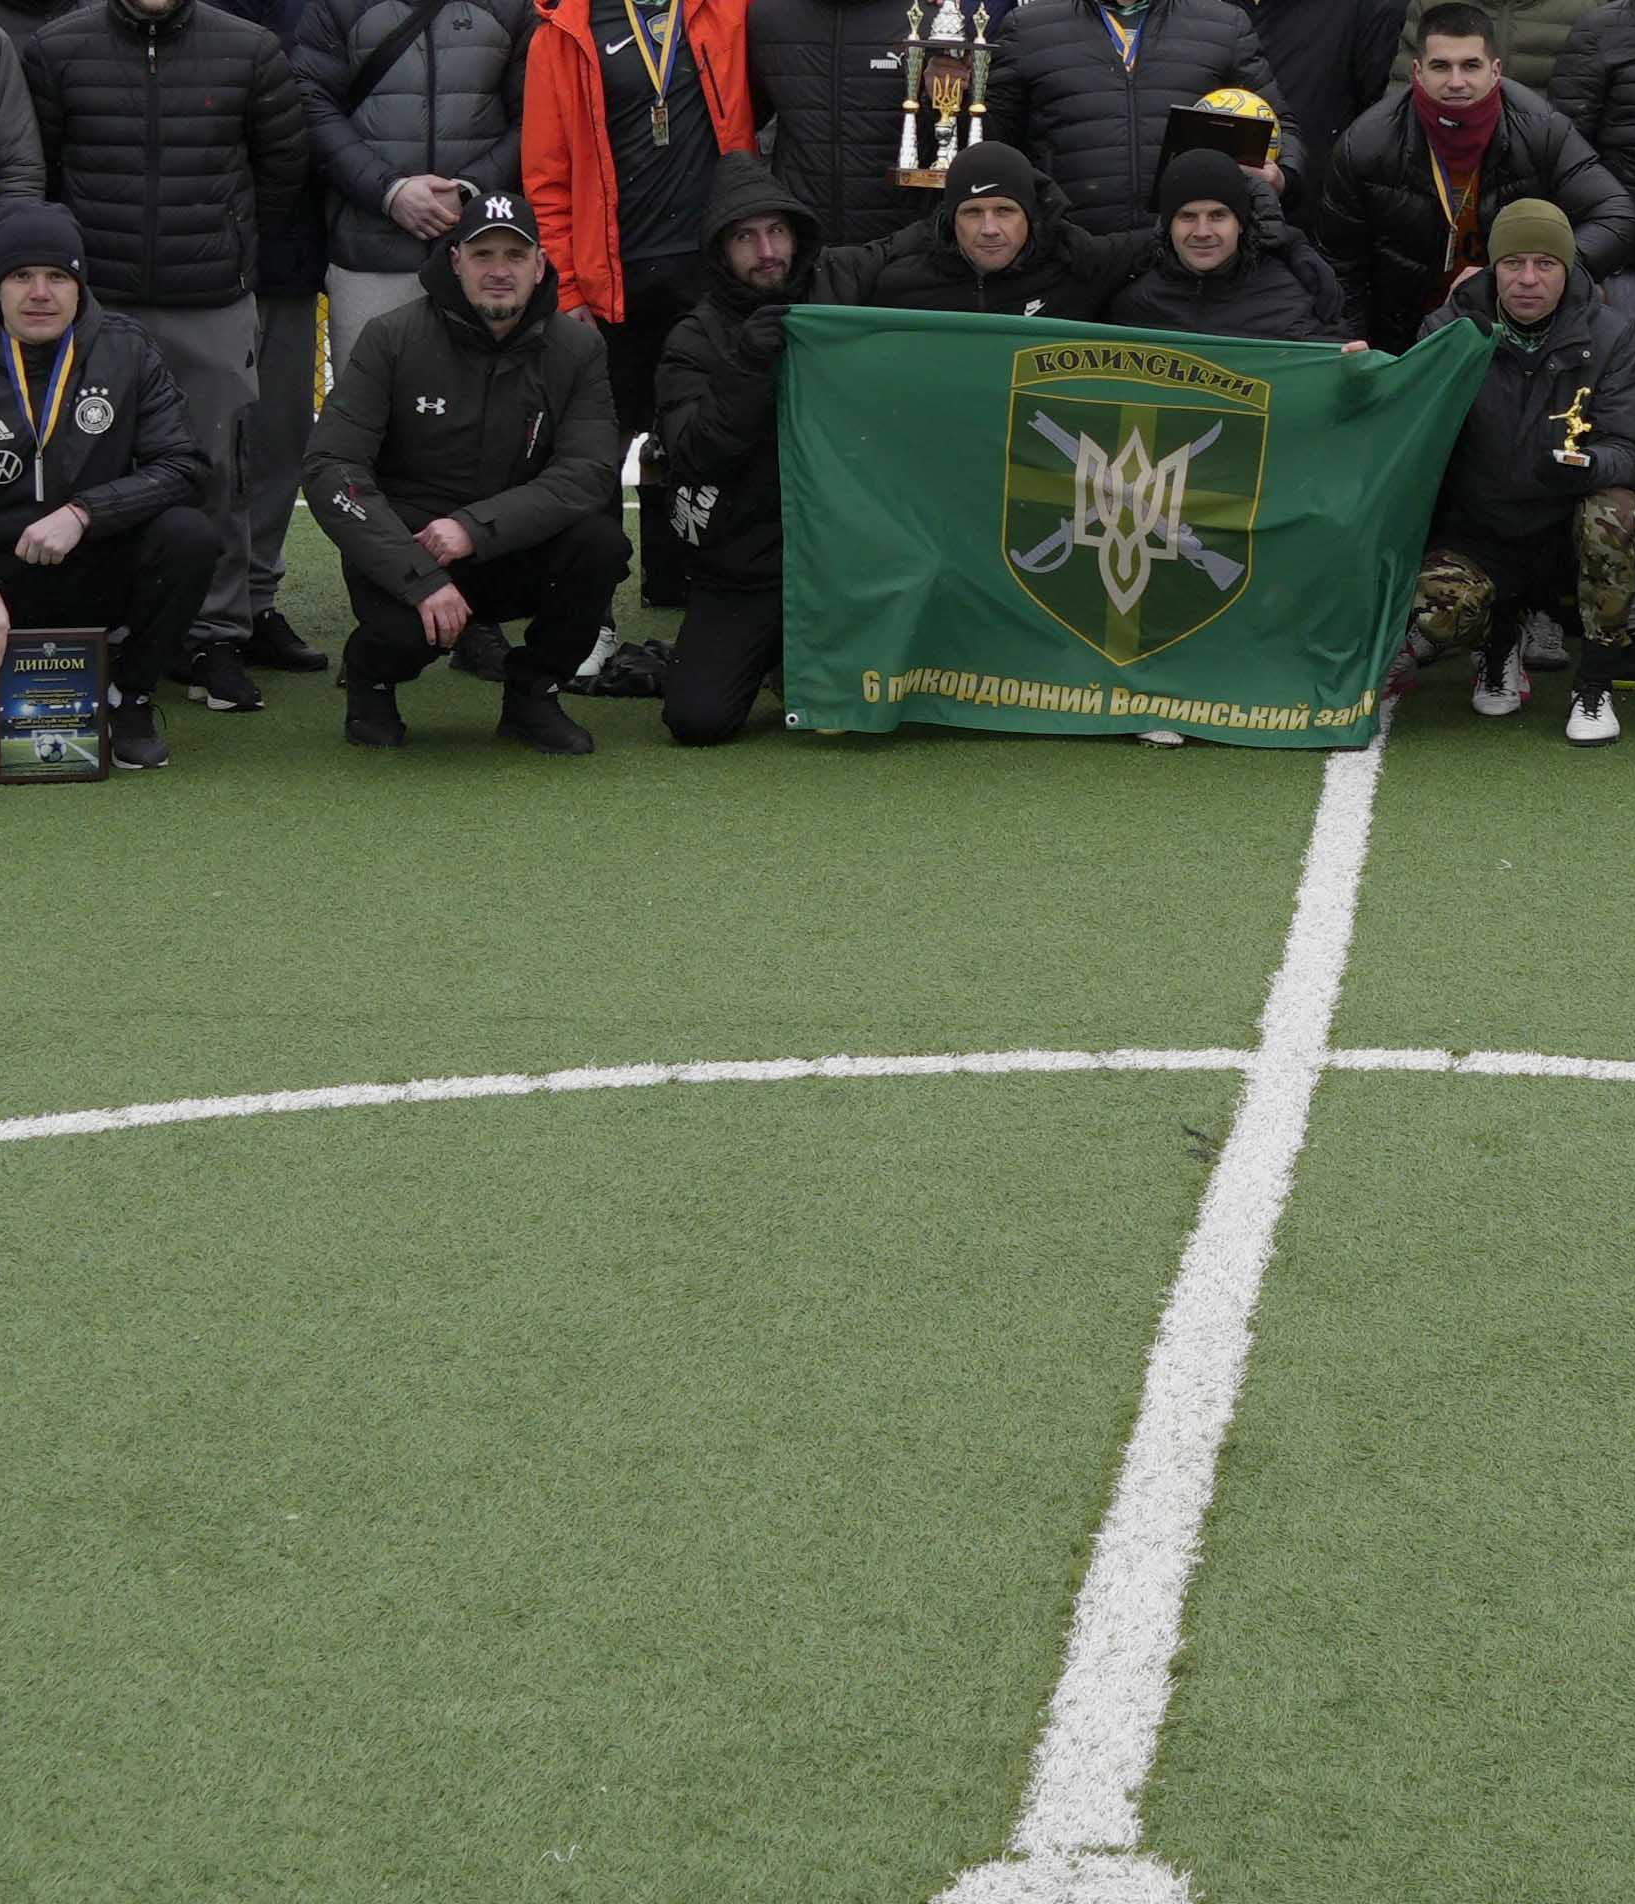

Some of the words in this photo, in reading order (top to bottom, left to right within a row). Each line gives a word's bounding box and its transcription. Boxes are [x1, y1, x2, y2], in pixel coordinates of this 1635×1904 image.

[485, 196, 514, 219] NY
[1034, 349, 1255, 398] ВОЛИНСЬКИЙ
[14, 658, 85, 673] ДИПЛОМ
[861, 670, 879, 703] 6
[1109, 686, 1310, 731] Волинський
